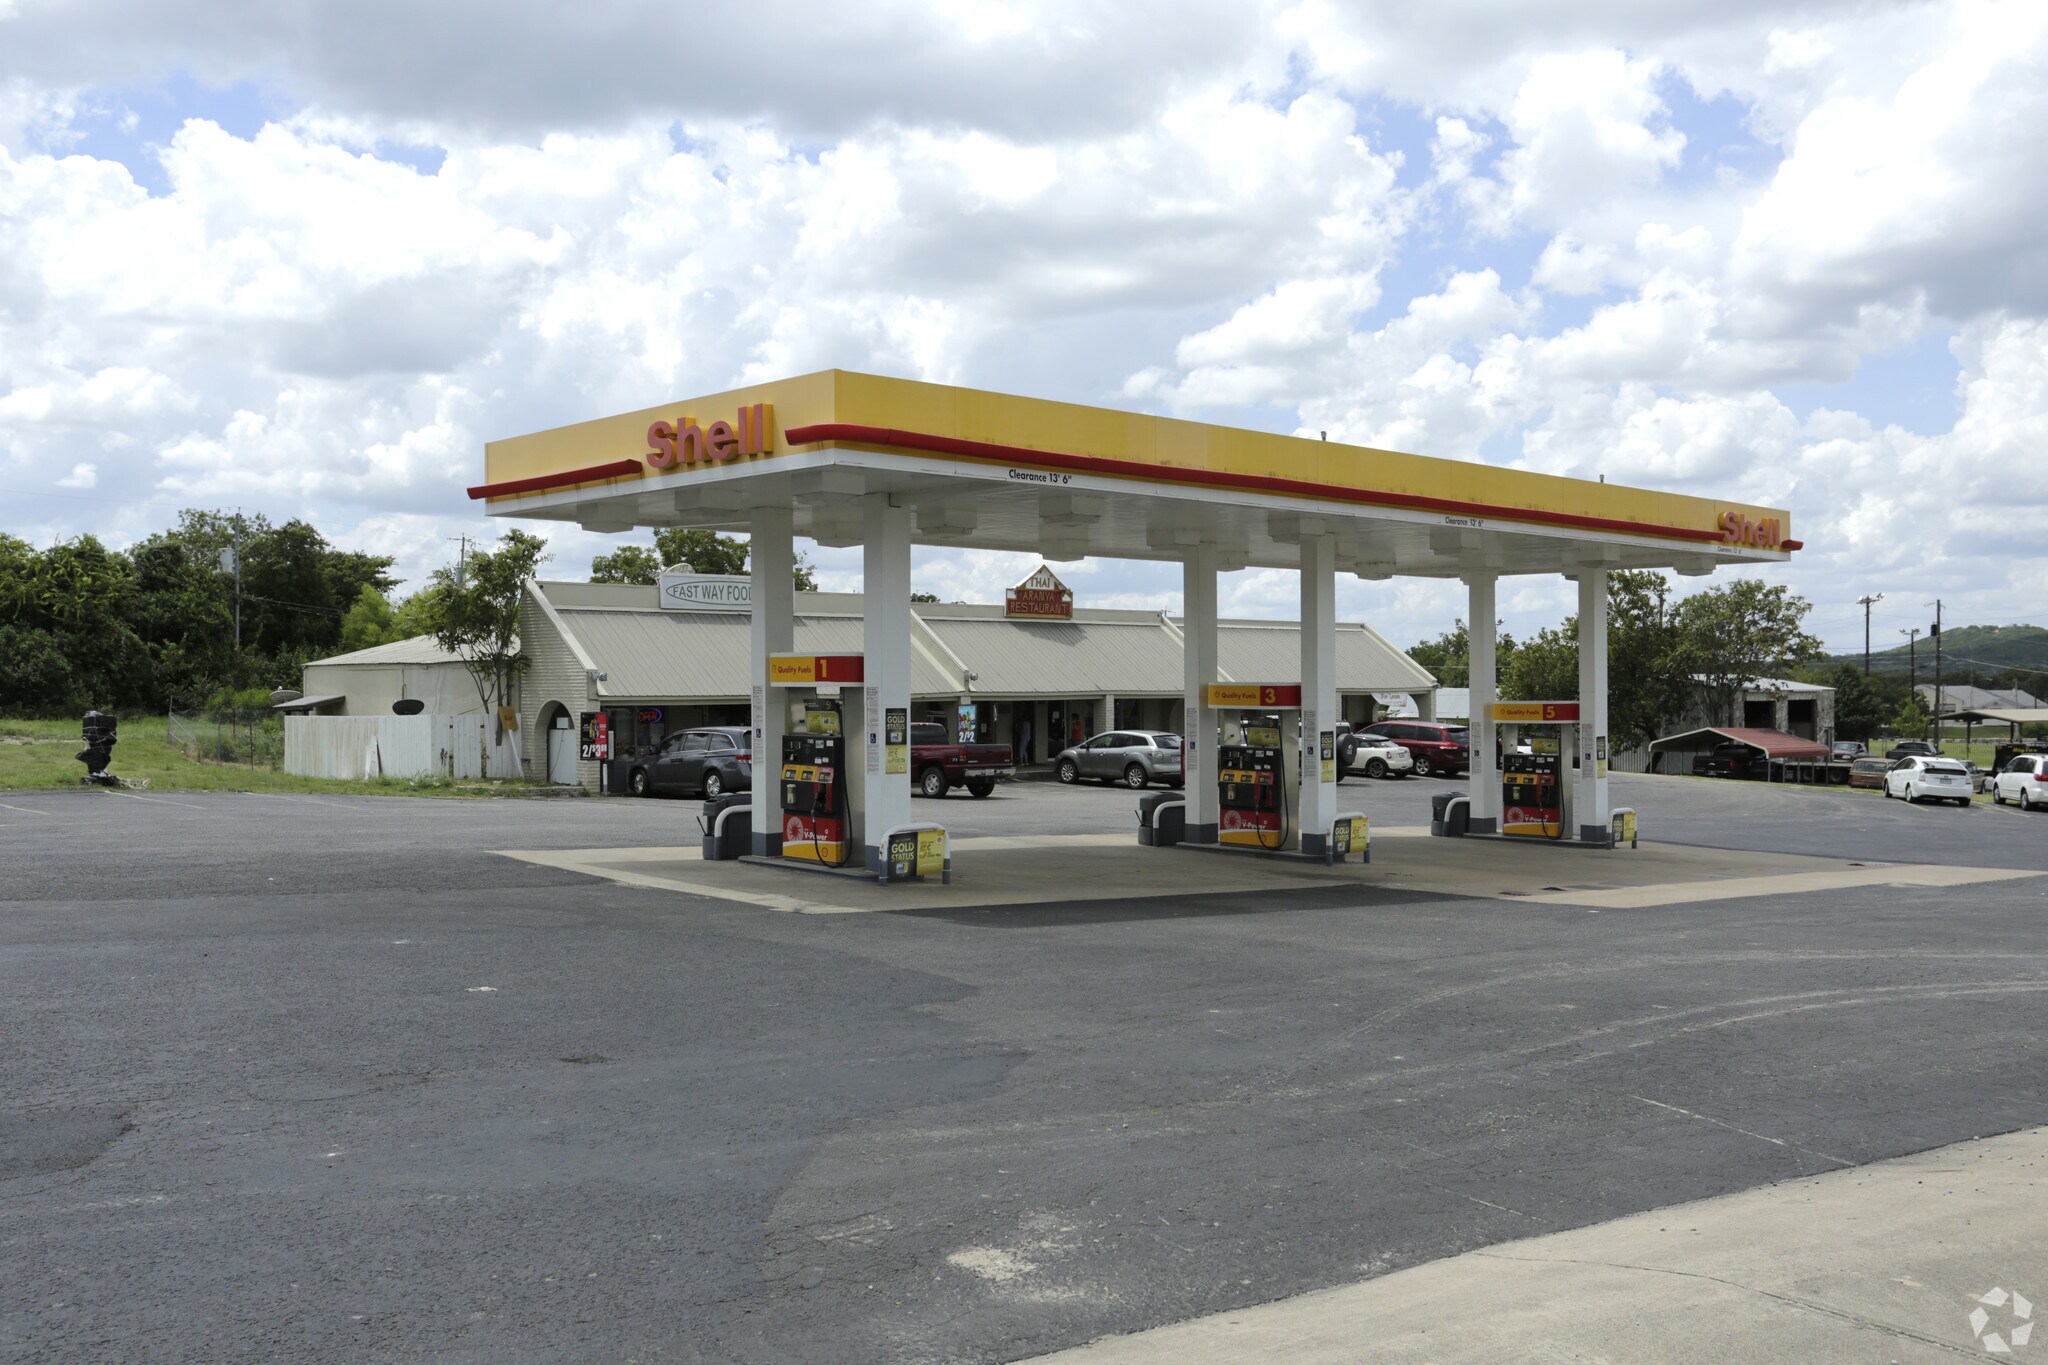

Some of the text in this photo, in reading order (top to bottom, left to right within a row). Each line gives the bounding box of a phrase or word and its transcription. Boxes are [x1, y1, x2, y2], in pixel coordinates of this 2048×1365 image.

[646, 403, 774, 469] Shell
[1008, 468, 1047, 482] Clearance
[1049, 472, 1060, 483] 13'
[1718, 512, 1780, 547] Shell
[673, 585, 699, 598] FAST
[702, 584, 725, 600] WAY
[1023, 590, 1055, 602] ARANYA
[1010, 601, 1068, 614] RESTAURANT
[777, 659, 828, 678] Quality Fuels 1
[1221, 692, 1241, 700] Quality
[1265, 688, 1276, 704] 3
[887, 715, 906, 724] GOLD
[1546, 706, 1556, 719] 5
[891, 842, 915, 853] GOLD
[891, 852, 915, 862] STATUS
